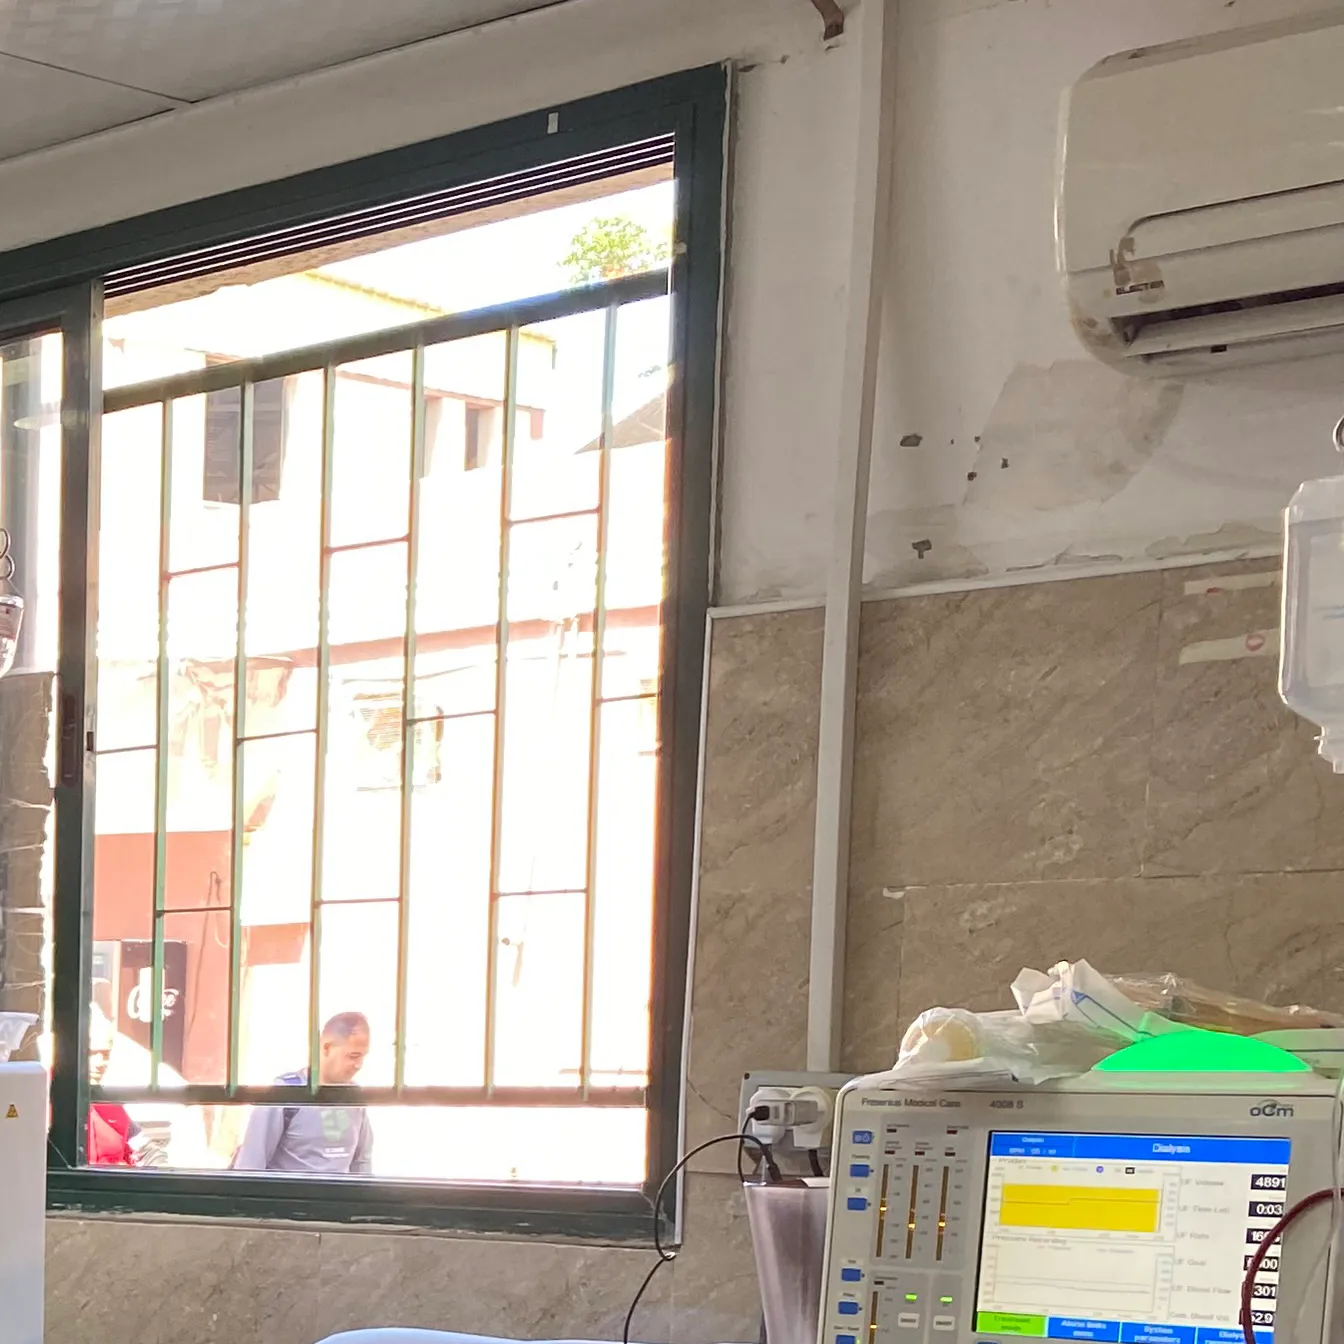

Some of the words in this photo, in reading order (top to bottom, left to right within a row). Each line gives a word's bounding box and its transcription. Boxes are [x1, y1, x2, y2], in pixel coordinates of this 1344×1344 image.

[1255, 1177, 1285, 1188] 4891
[1256, 1204, 1282, 1215] 0:03
[1254, 1286, 1276, 1297] 301
